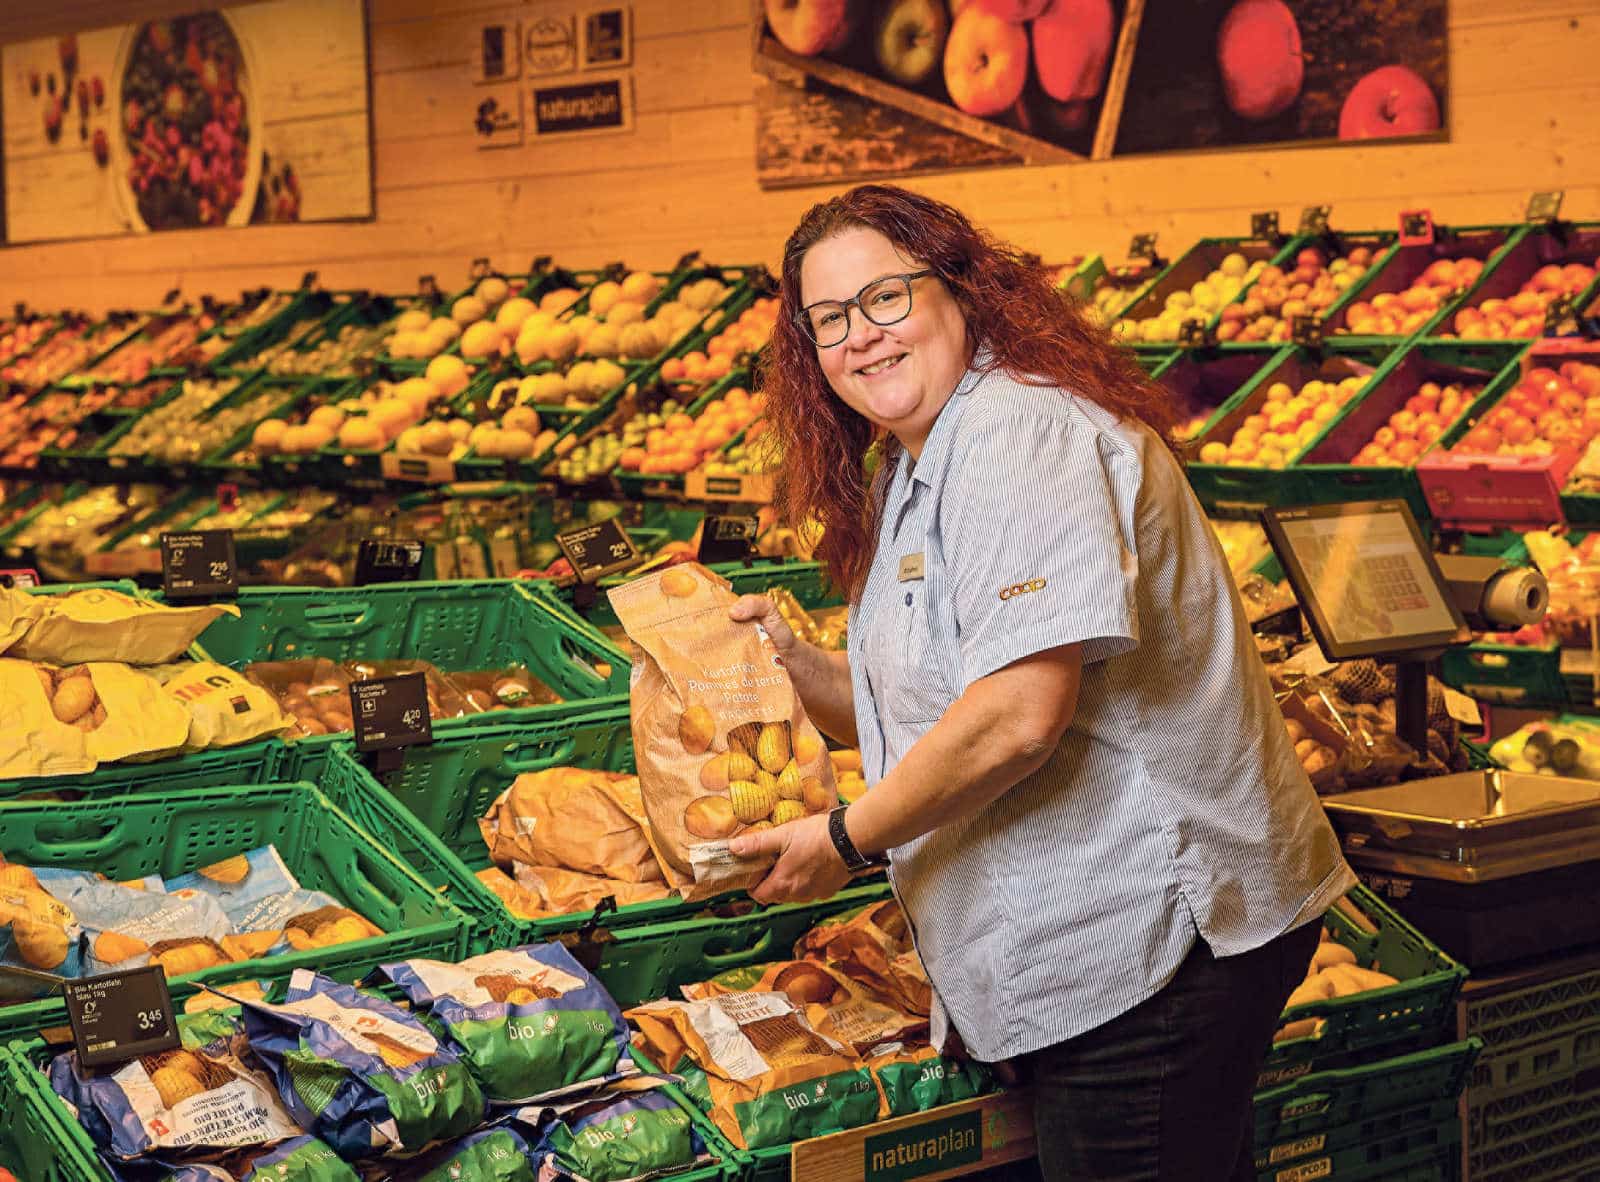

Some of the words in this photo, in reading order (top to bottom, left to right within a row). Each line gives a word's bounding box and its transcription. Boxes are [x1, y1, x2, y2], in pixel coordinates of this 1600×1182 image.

[999, 576, 1046, 601] coop
[88, 979, 122, 992] Kartoffeln
[507, 1021, 535, 1041] bio
[783, 1091, 810, 1111] bio
[583, 1130, 616, 1149] bio
[872, 1127, 976, 1172] naturaplan
